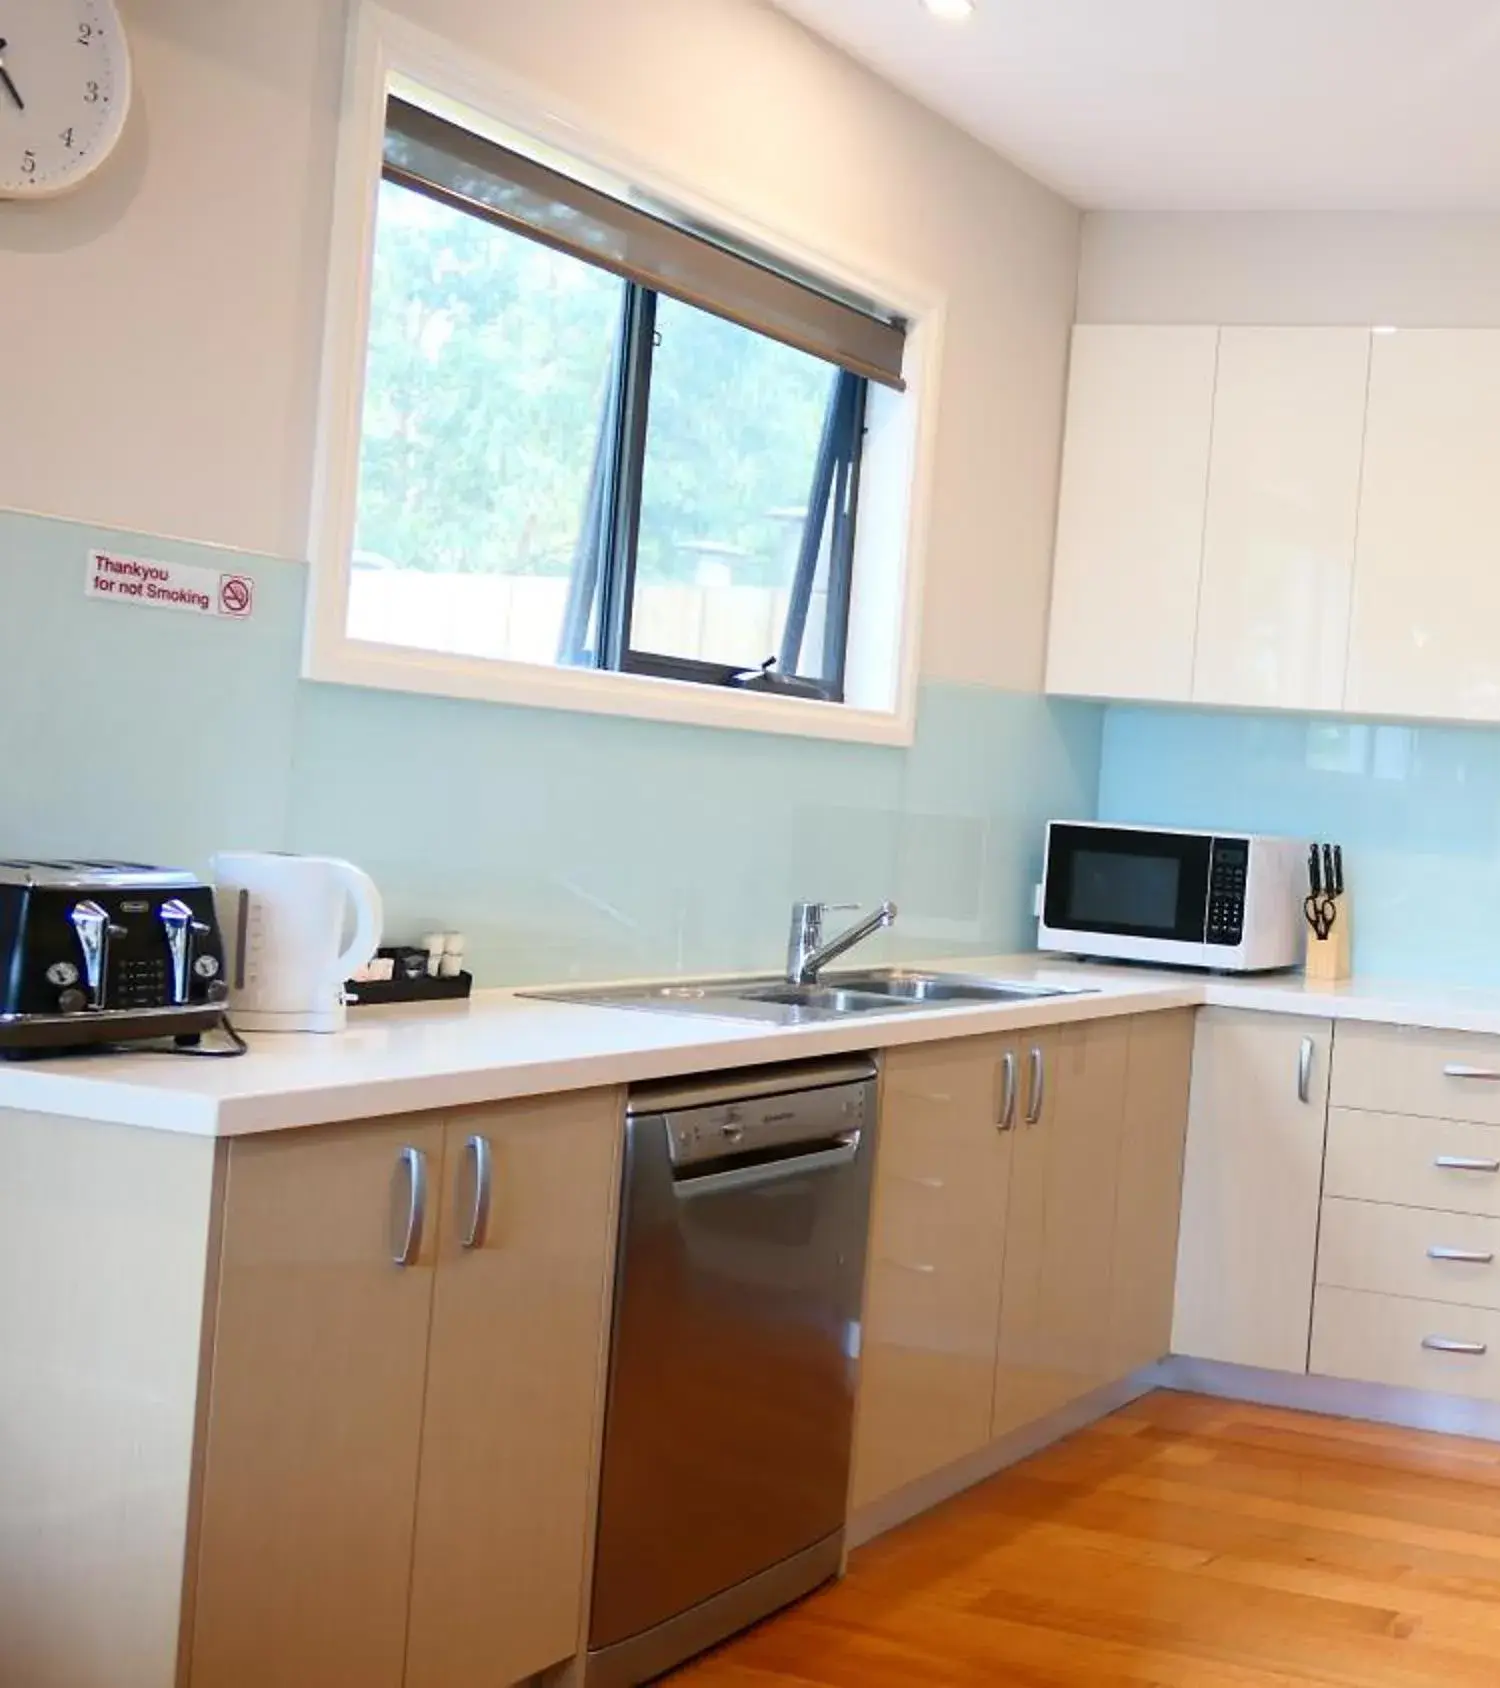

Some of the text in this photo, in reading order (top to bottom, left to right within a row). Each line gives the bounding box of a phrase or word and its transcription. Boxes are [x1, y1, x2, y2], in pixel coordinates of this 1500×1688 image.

[77, 23, 92, 46] 2
[83, 80, 99, 103] 3
[58, 127, 74, 148] 4
[21, 150, 36, 174] 5
[95, 555, 169, 581] Thankyou
[94, 576, 209, 609] for not Smoking
